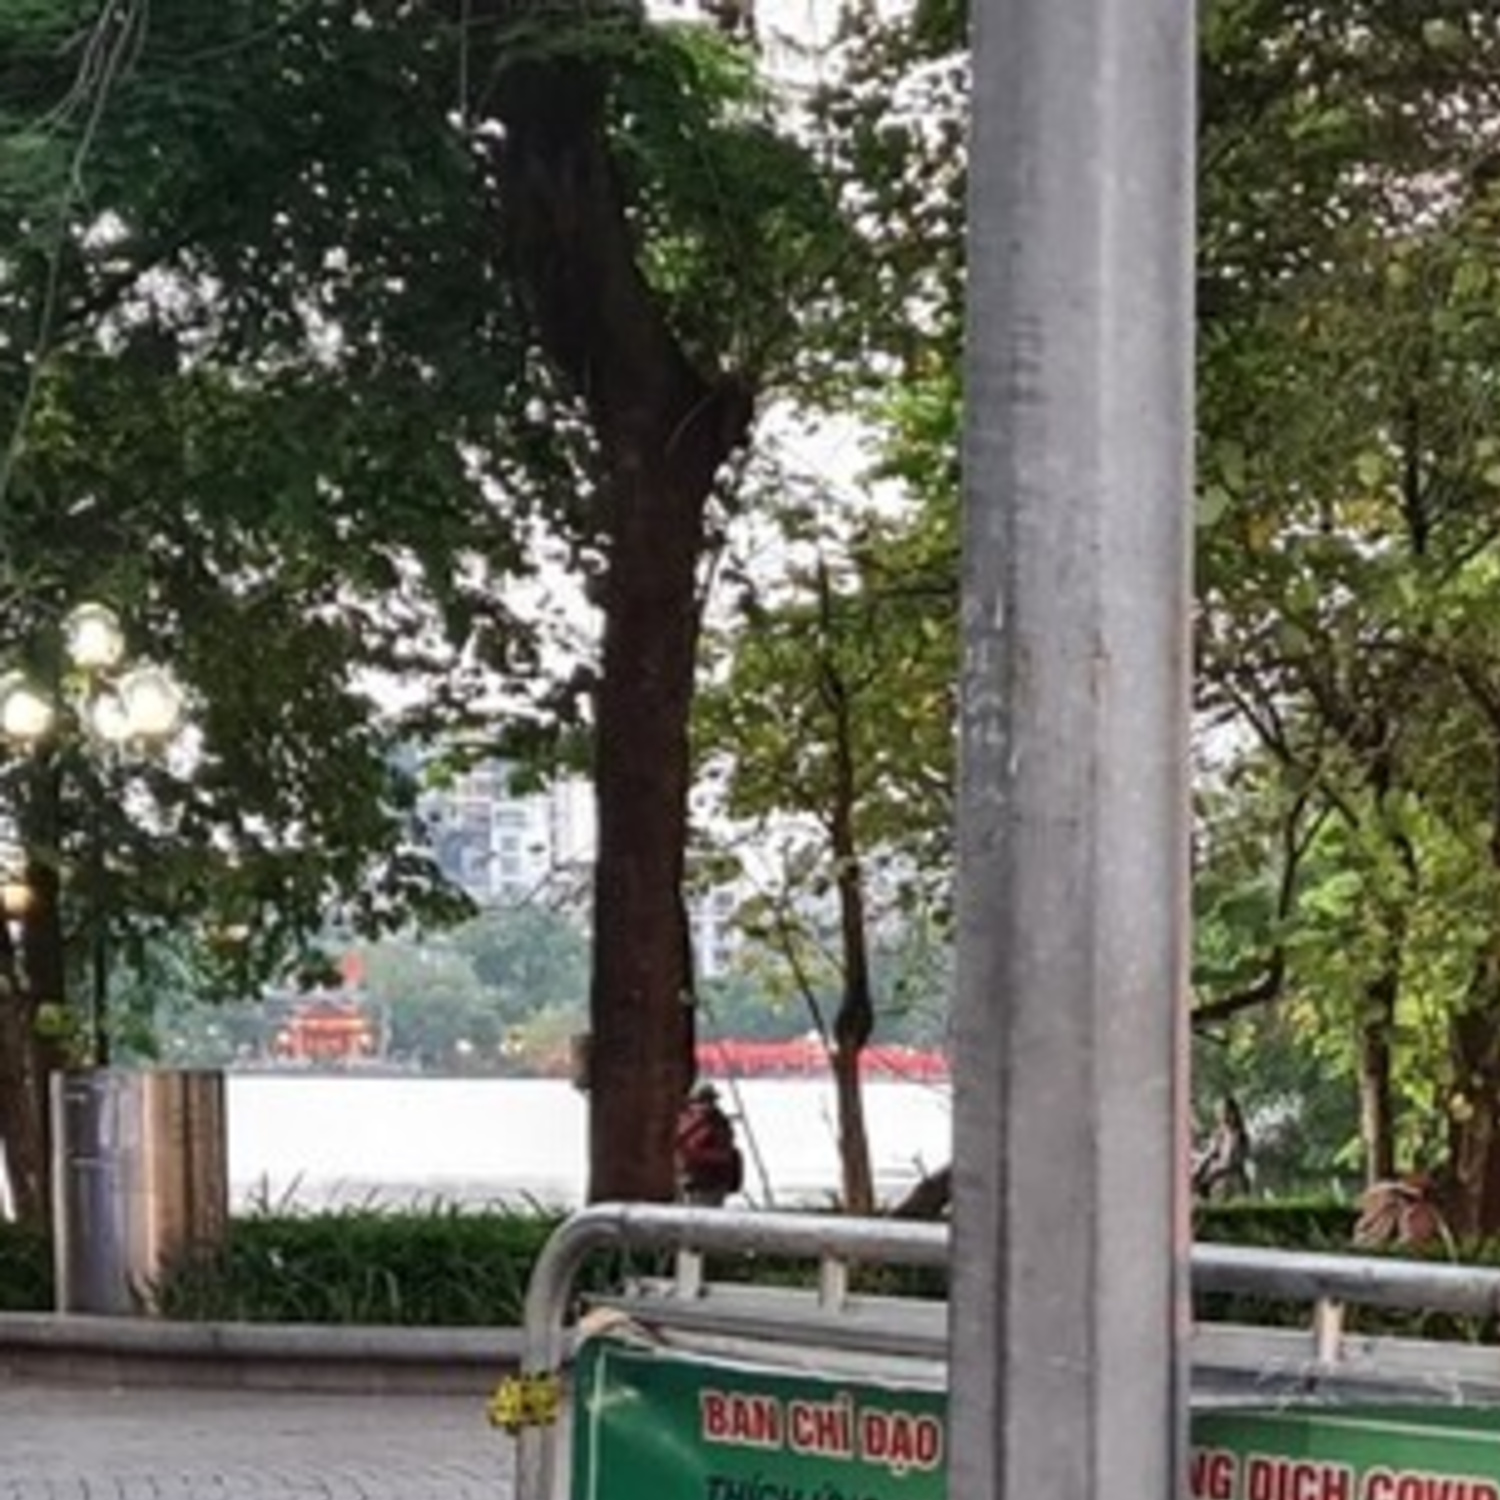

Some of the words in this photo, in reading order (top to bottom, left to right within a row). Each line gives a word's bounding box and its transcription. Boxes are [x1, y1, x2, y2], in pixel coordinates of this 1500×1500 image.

[700, 1390, 778, 1450] BAN
[790, 1392, 853, 1459] CHỈ
[861, 1410, 943, 1477] ĐẠO
